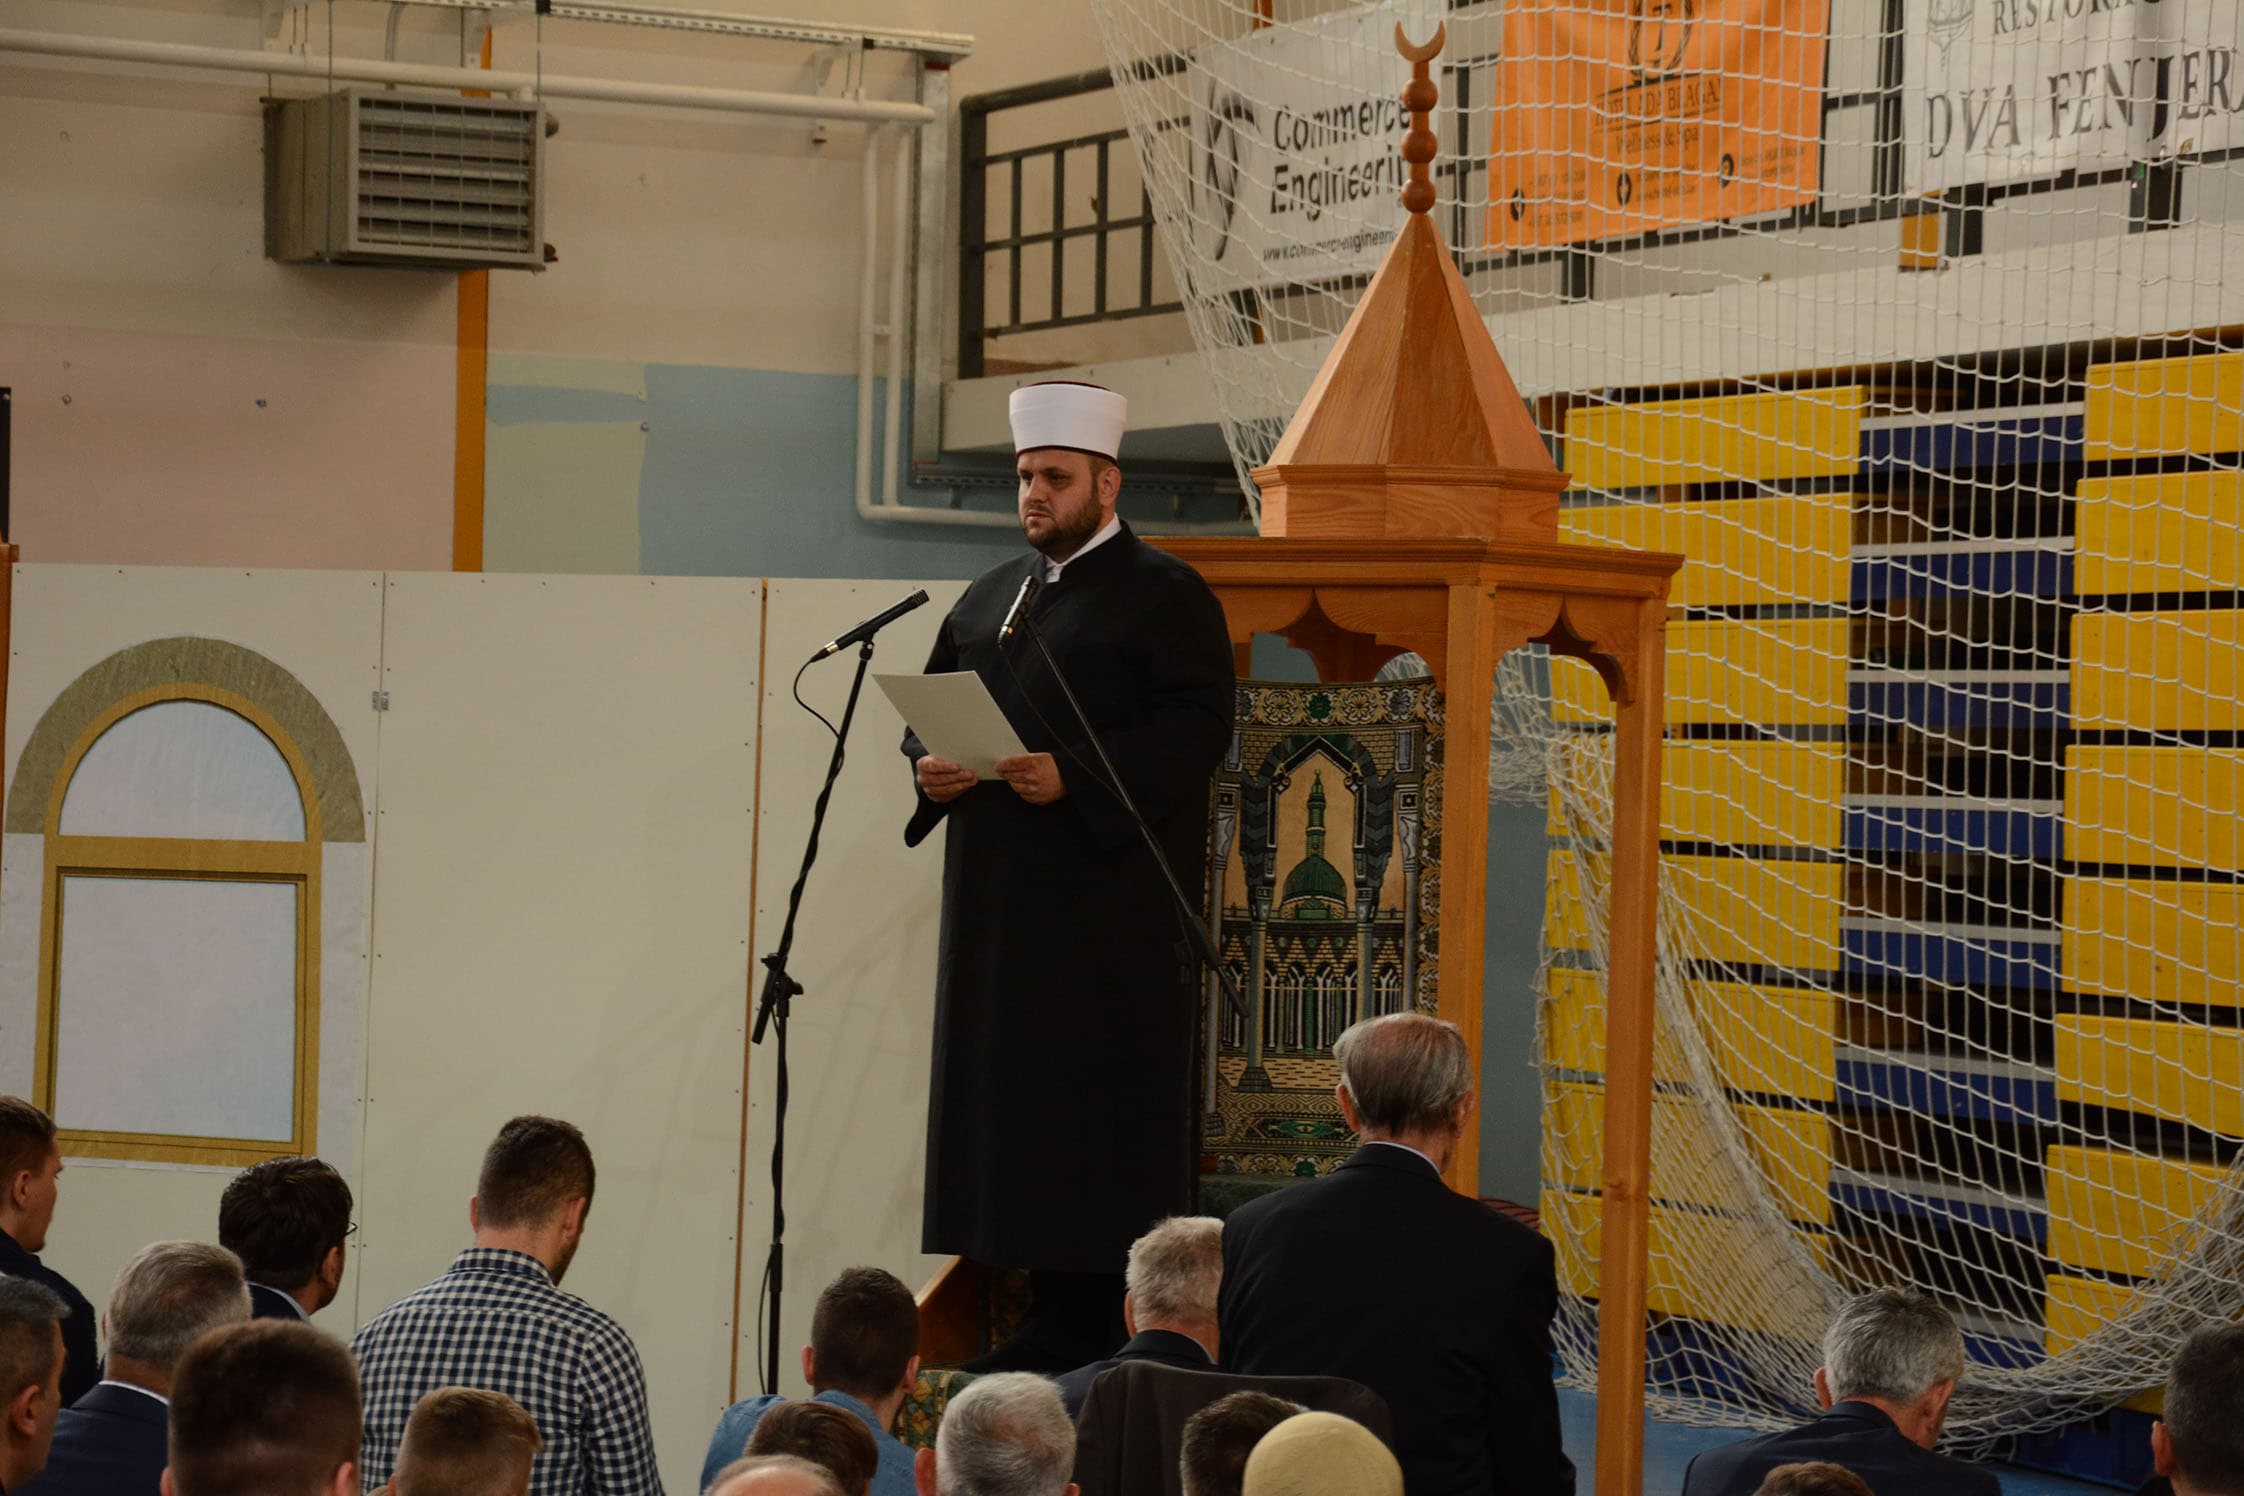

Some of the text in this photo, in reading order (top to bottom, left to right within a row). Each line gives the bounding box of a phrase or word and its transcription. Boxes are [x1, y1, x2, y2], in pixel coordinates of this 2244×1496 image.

[1992, 0, 2161, 35] RESTO
[1274, 96, 1410, 151] Commerce
[1926, 46, 2244, 159] DVA FENJER
